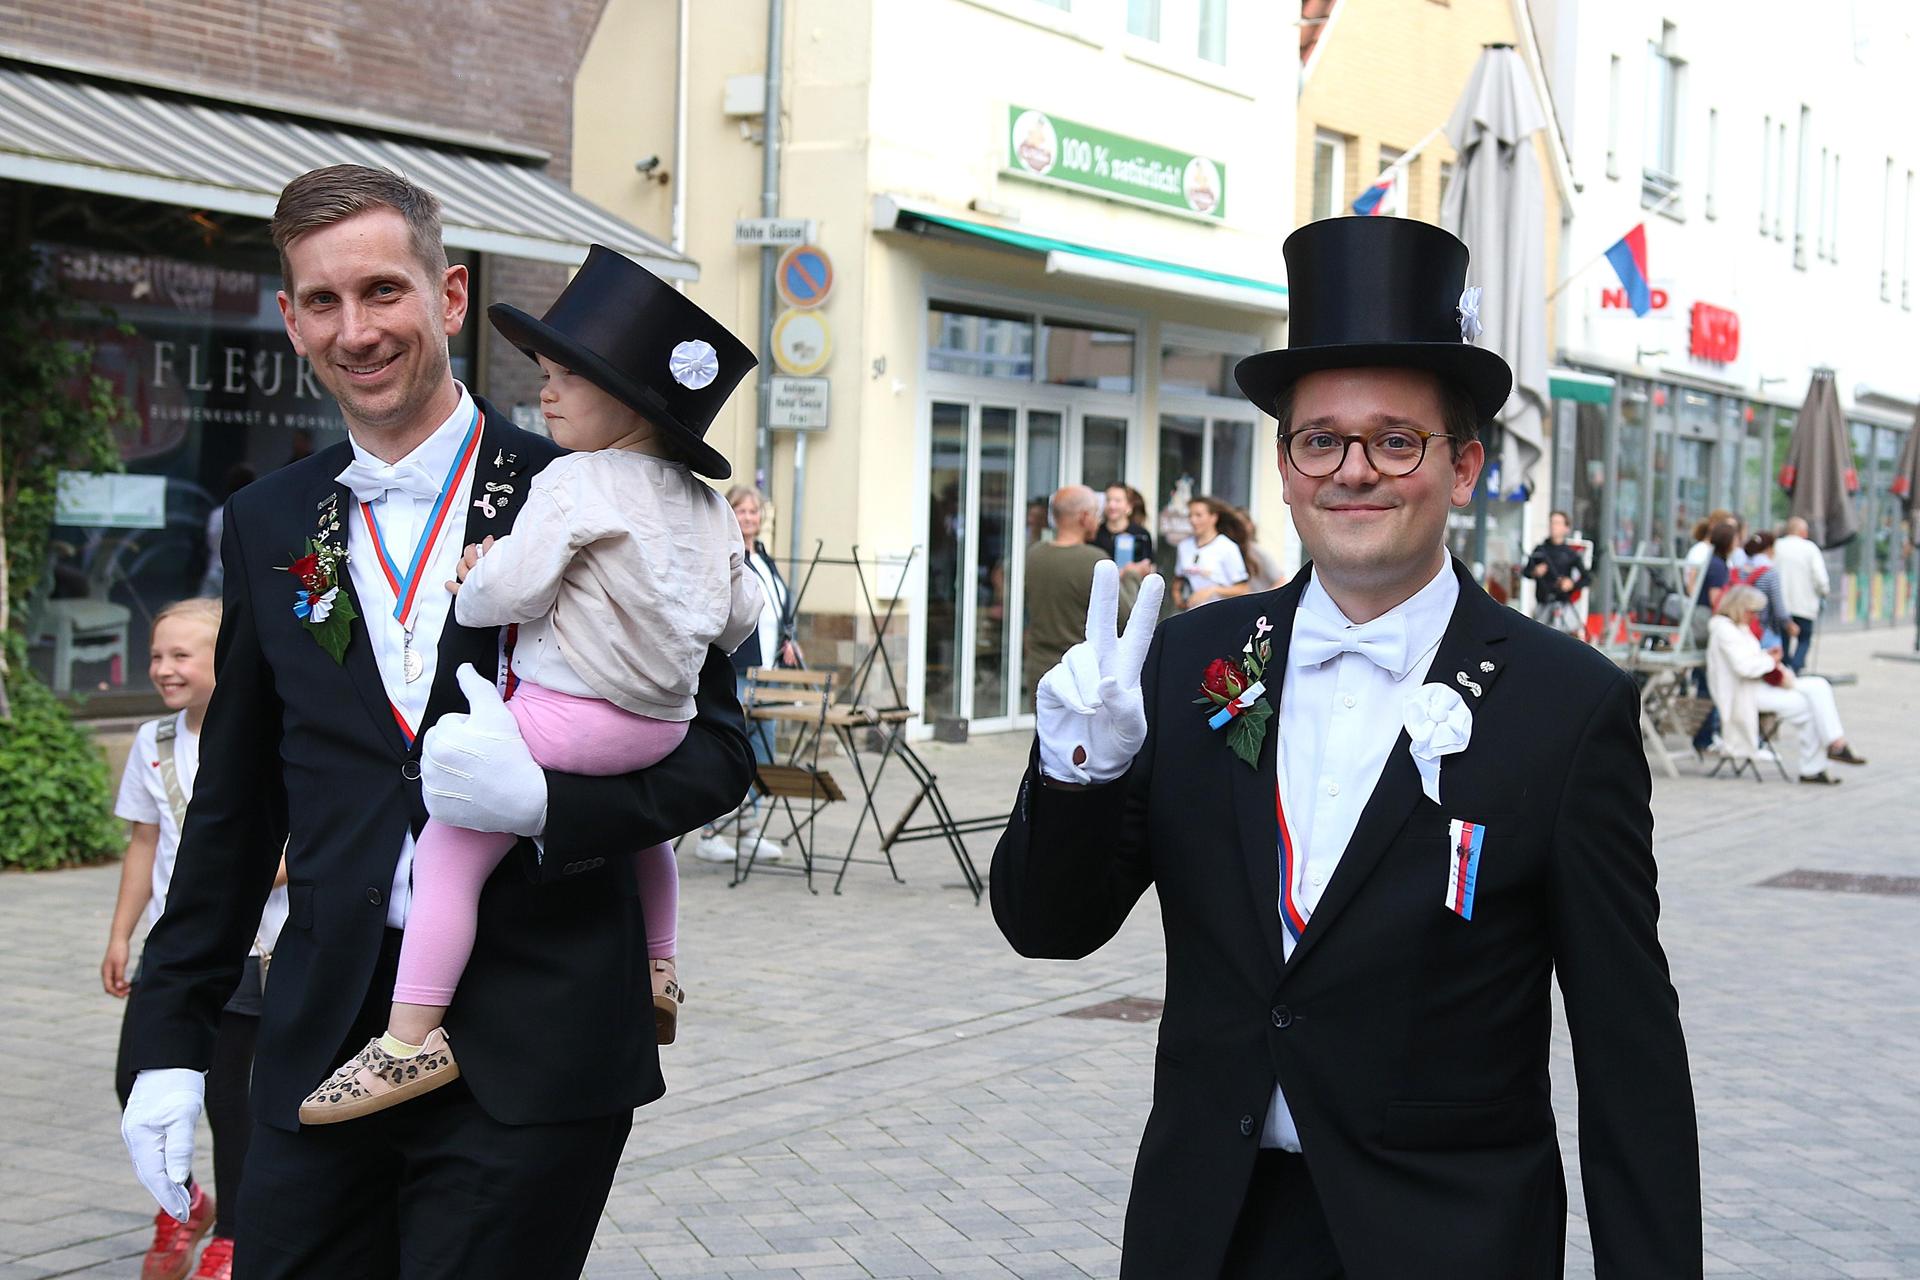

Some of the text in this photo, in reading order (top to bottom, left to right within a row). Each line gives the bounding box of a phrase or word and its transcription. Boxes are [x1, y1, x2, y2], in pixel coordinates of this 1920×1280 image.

[1062, 137, 1091, 172] 100
[1094, 144, 1110, 177] %
[1111, 157, 1181, 193] natürlich!
[735, 223, 802, 240] Hohe Gasse
[153, 341, 323, 400] FLEUR
[150, 403, 262, 425] BLUMENKUNST
[285, 412, 345, 431] WOHNLI
